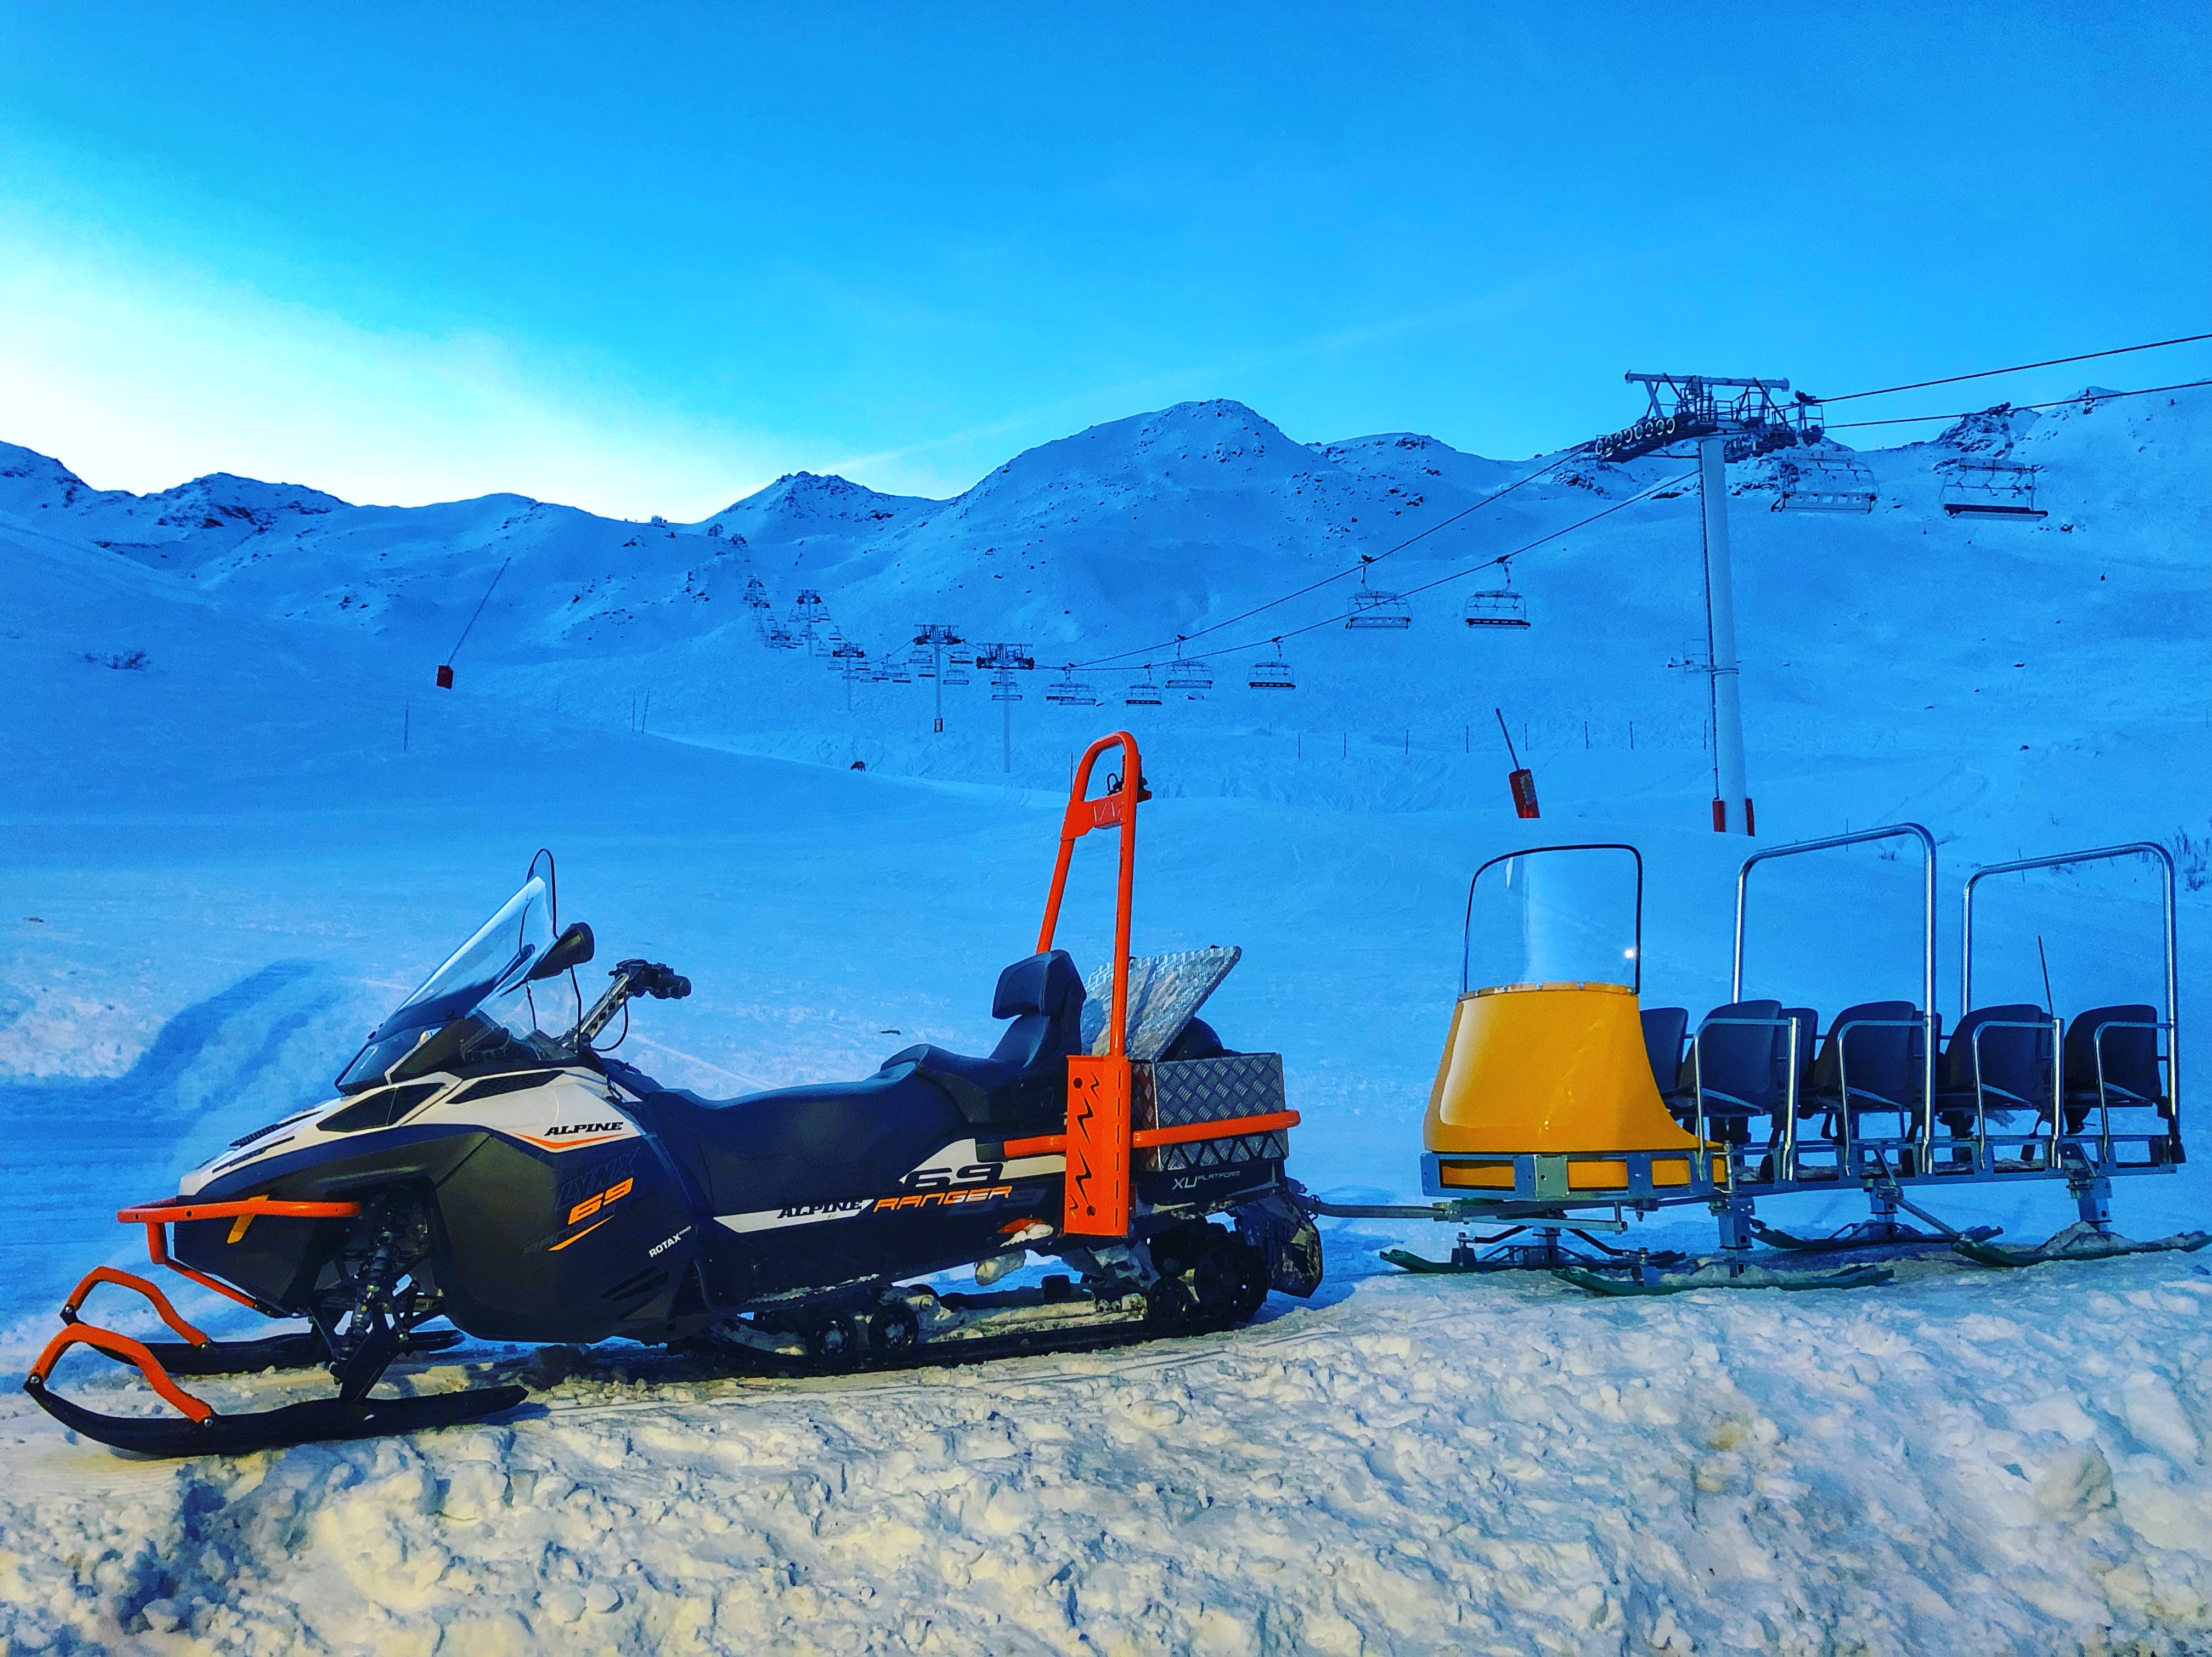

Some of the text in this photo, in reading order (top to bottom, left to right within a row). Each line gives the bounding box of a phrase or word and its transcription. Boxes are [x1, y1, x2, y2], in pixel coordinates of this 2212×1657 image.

[544, 1122, 624, 1136] ALPINE
[904, 1162, 1004, 1190] 69
[1172, 1170, 1240, 1190] XU PLATFORM
[568, 1177, 634, 1225] 69
[777, 1200, 864, 1219] ALPINE
[873, 1185, 1013, 1213] RANGER
[648, 1233, 681, 1258] ROTAX
